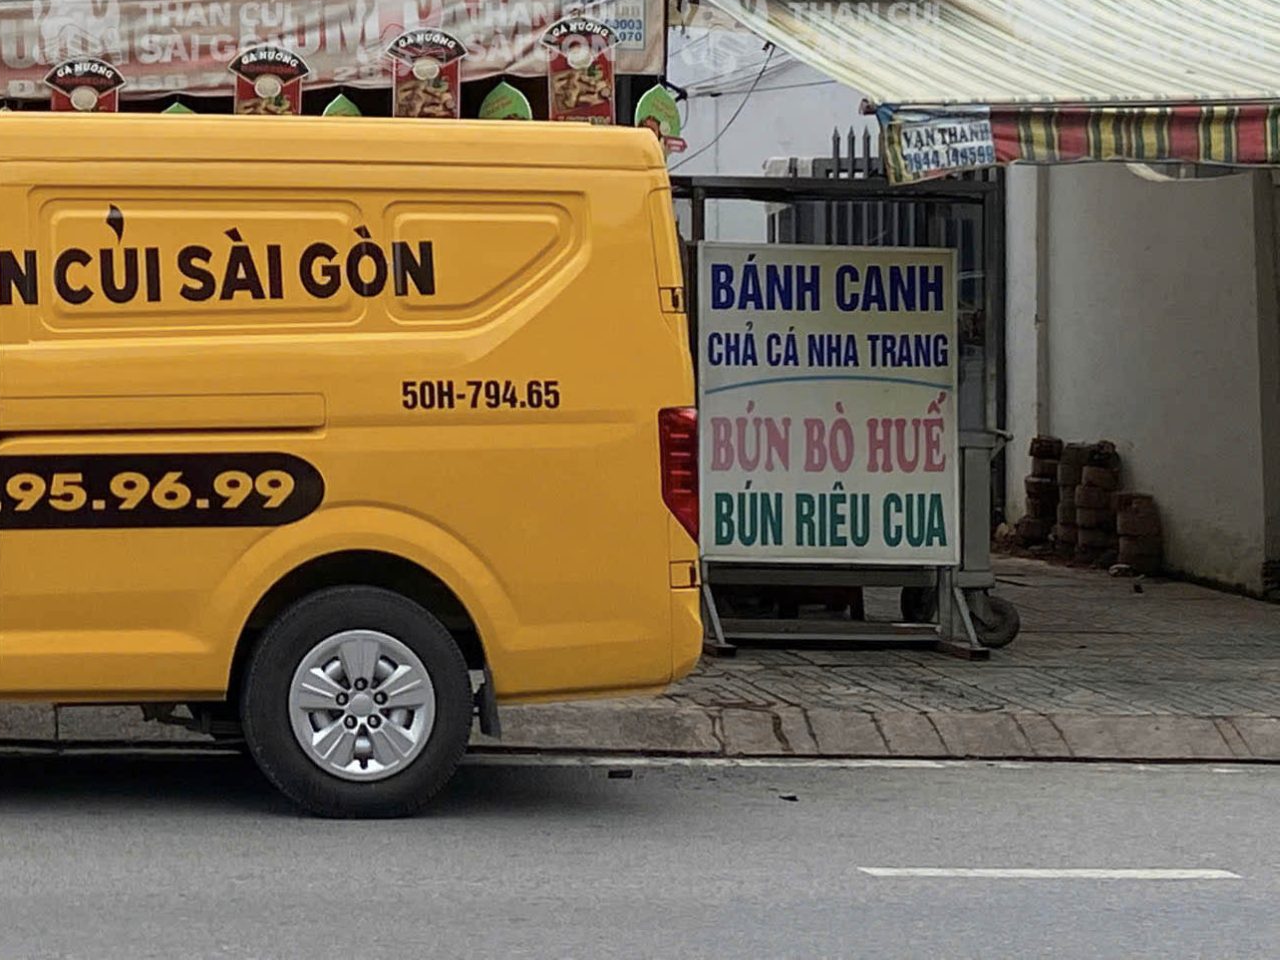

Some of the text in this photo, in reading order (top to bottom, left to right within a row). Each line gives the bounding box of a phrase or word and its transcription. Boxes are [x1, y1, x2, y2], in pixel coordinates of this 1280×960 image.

[177, 227, 284, 302] SÀI
[298, 225, 436, 298] GÒN
[710, 254, 944, 312] BÁNH CANH
[707, 321, 950, 368] CHẢ CÁ NHA TRANG
[401, 379, 561, 410] 50H-794.65
[710, 391, 947, 473] BÚN BÒ HUẾ
[714, 480, 948, 547] BÚN RIÊU CUA
